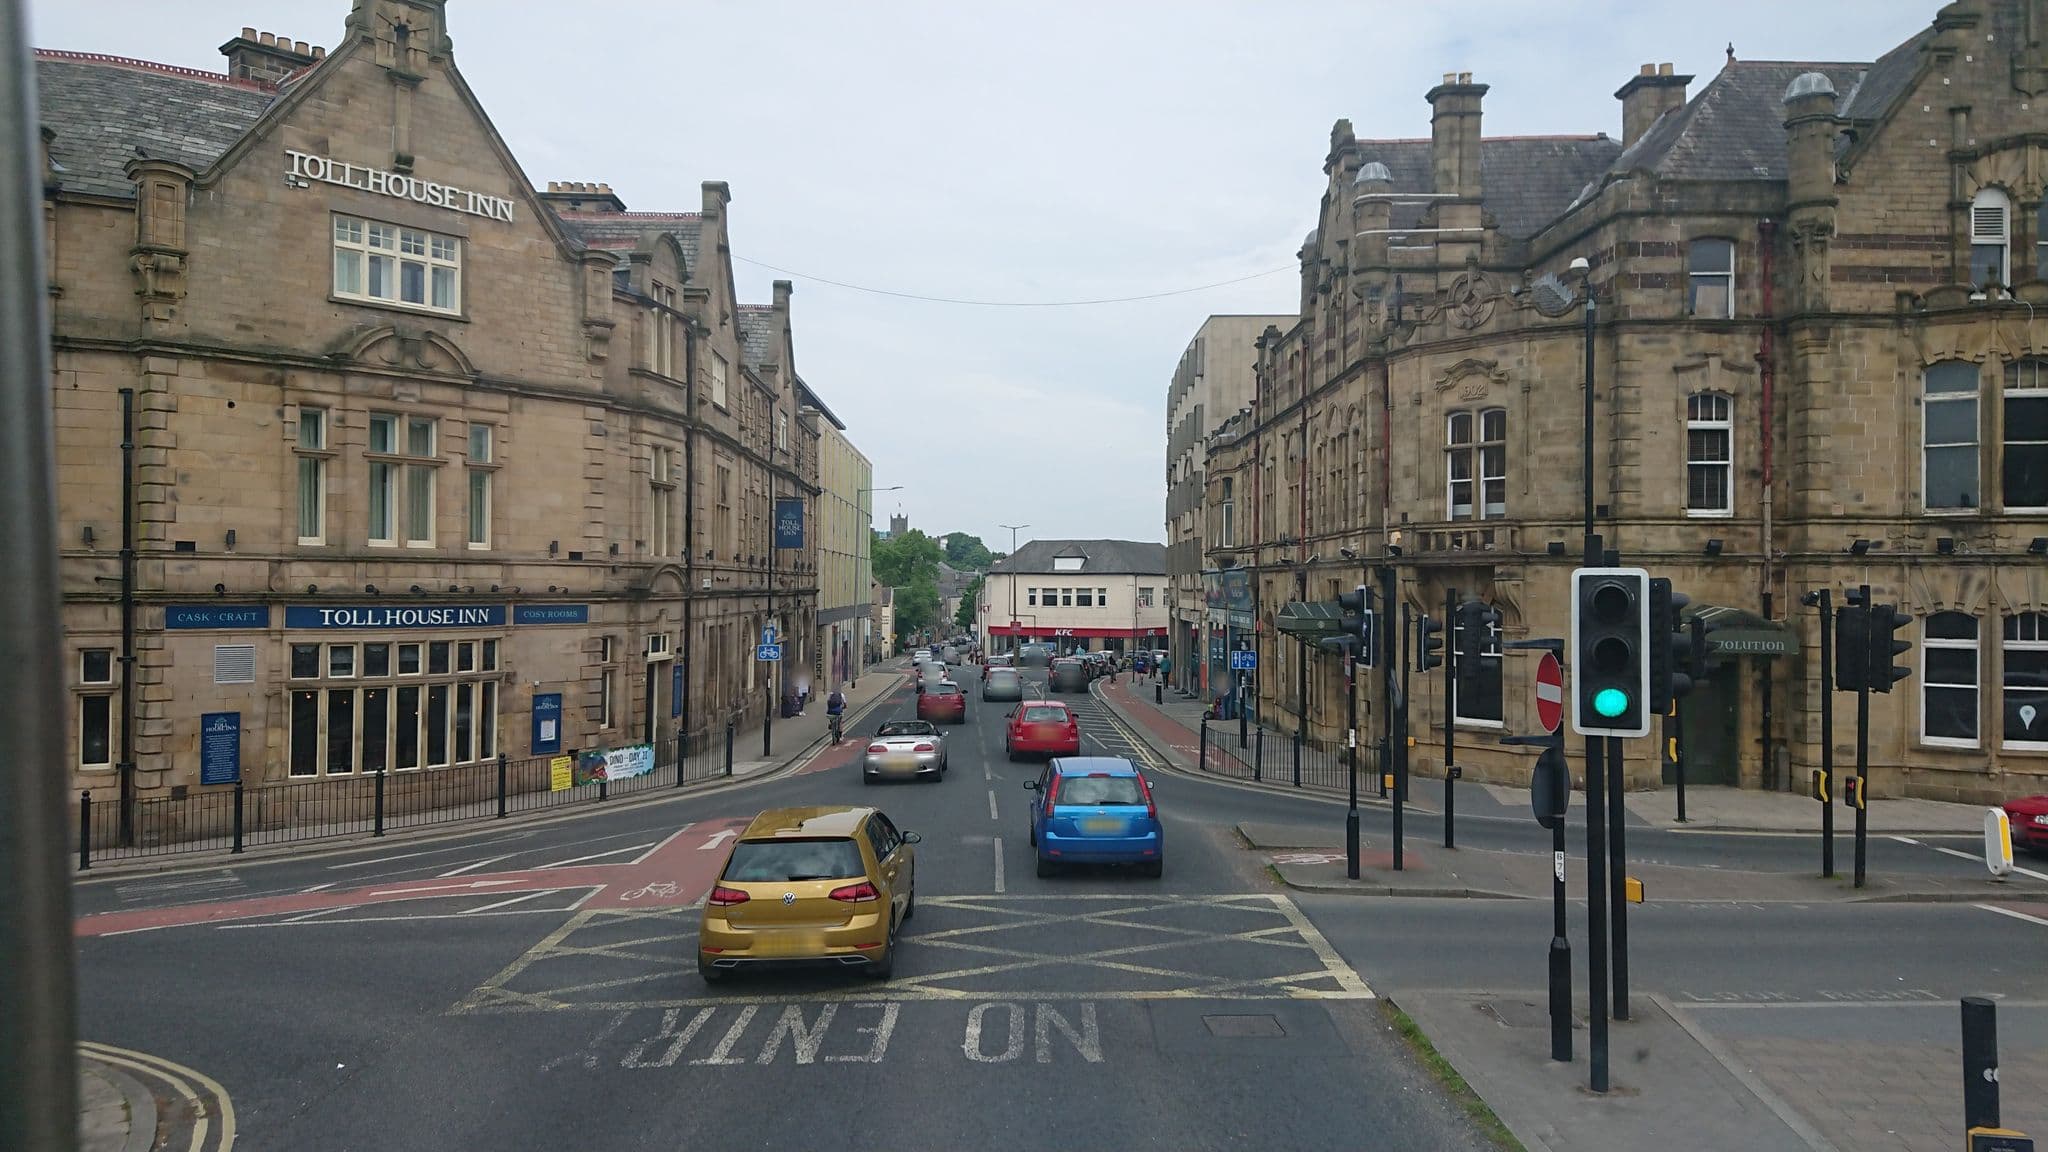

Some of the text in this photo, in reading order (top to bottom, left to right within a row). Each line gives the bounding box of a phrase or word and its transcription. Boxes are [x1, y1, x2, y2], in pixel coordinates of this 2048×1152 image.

[284, 150, 514, 223] TOLL HOUSE INN
[177, 612, 257, 622] CASK CRAFT
[319, 608, 490, 626] TOLL HOUSE INN
[523, 610, 578, 619] COSY ROOMS
[1055, 629, 1073, 637] KFC
[960, 1001, 1106, 1064] NO
